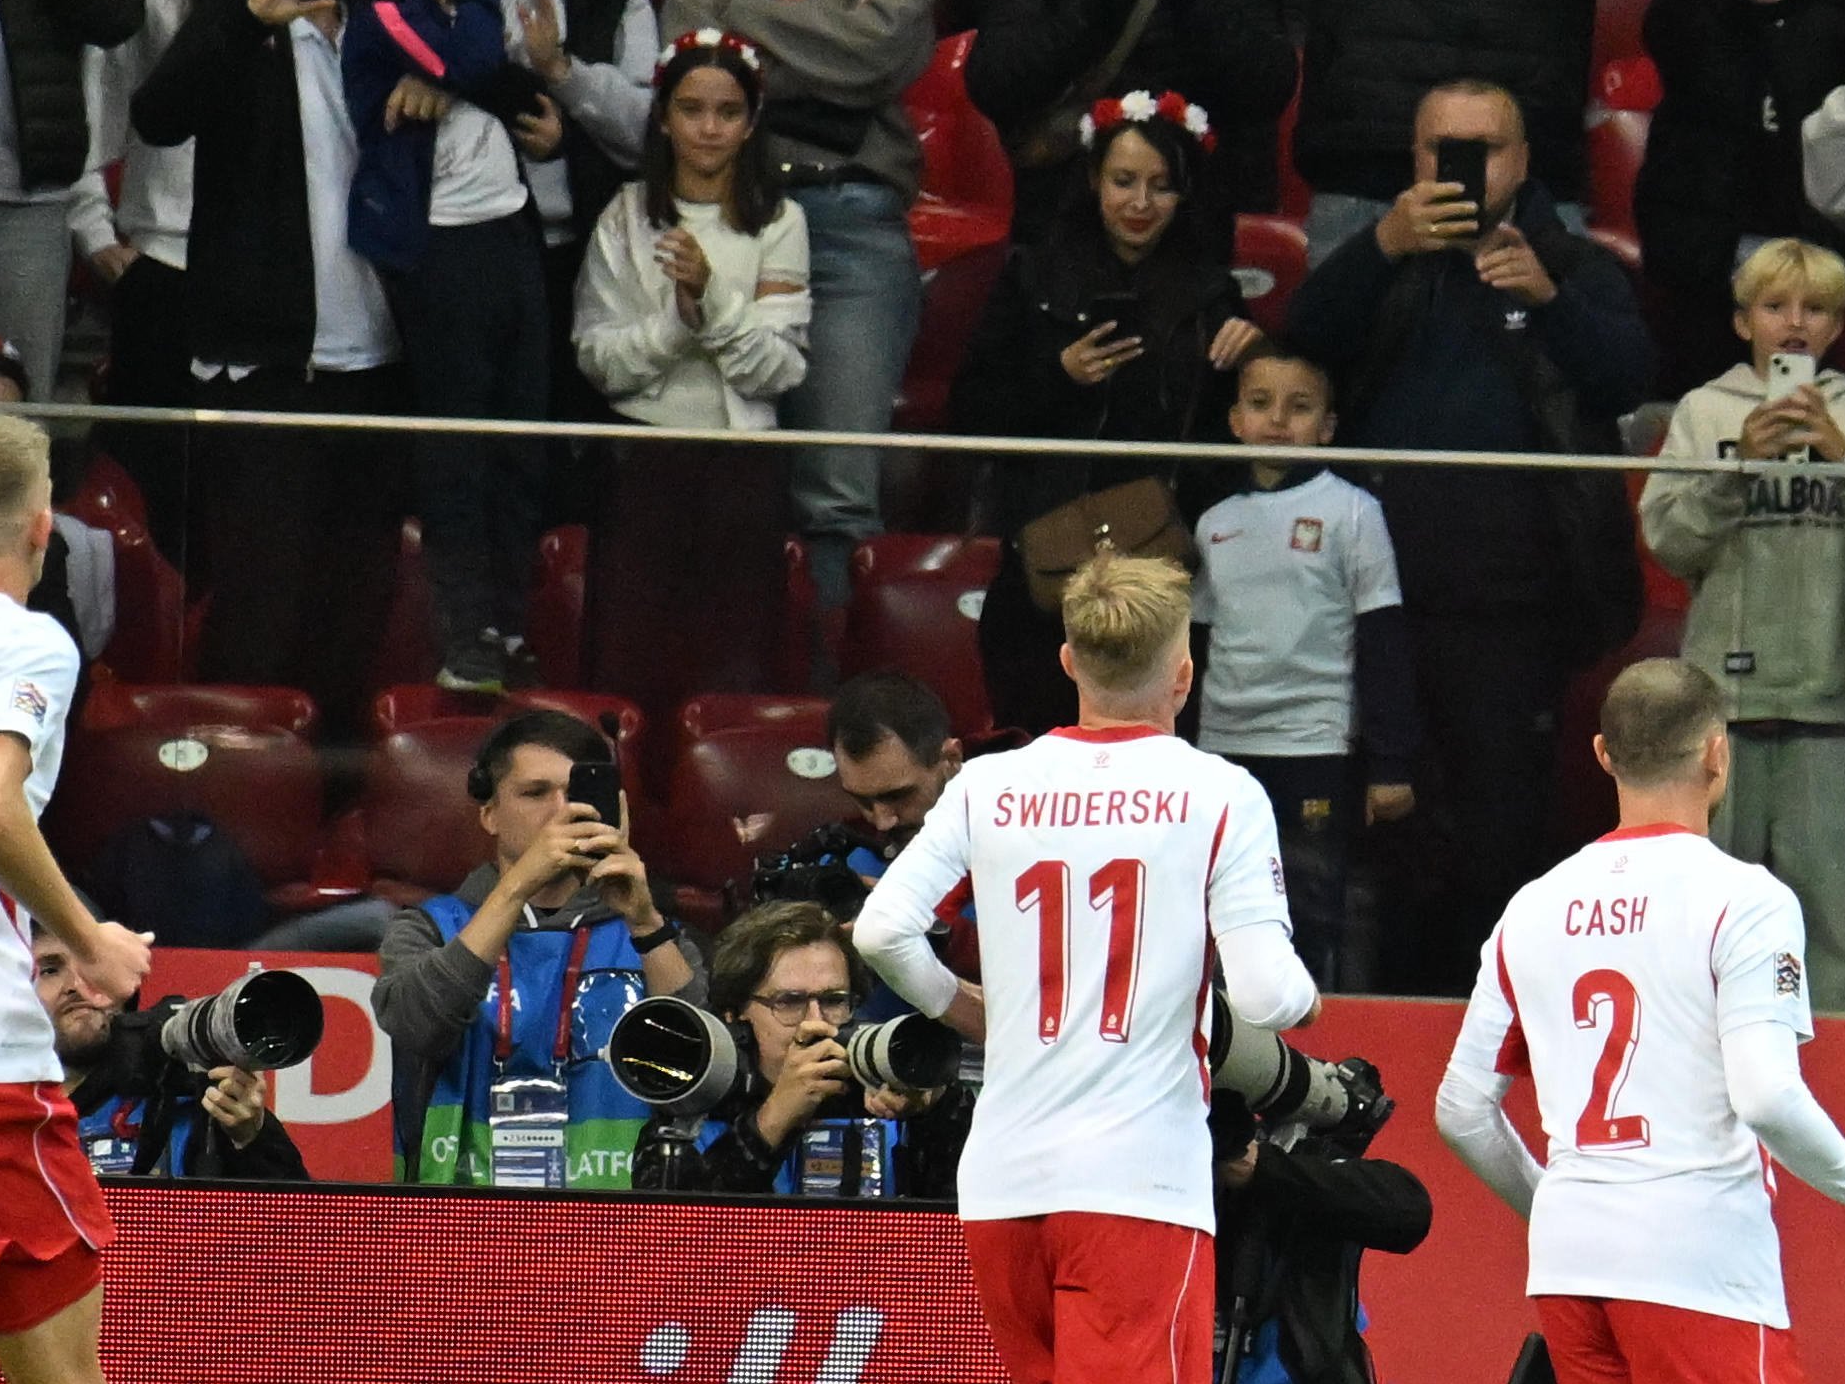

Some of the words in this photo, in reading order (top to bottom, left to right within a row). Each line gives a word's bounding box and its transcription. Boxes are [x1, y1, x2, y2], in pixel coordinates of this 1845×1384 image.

[993, 785, 1190, 828] ŚWIDERSKI
[1015, 858, 1147, 1046] 11
[1564, 895, 1649, 937] CASH
[1572, 968, 1652, 1152] 2
